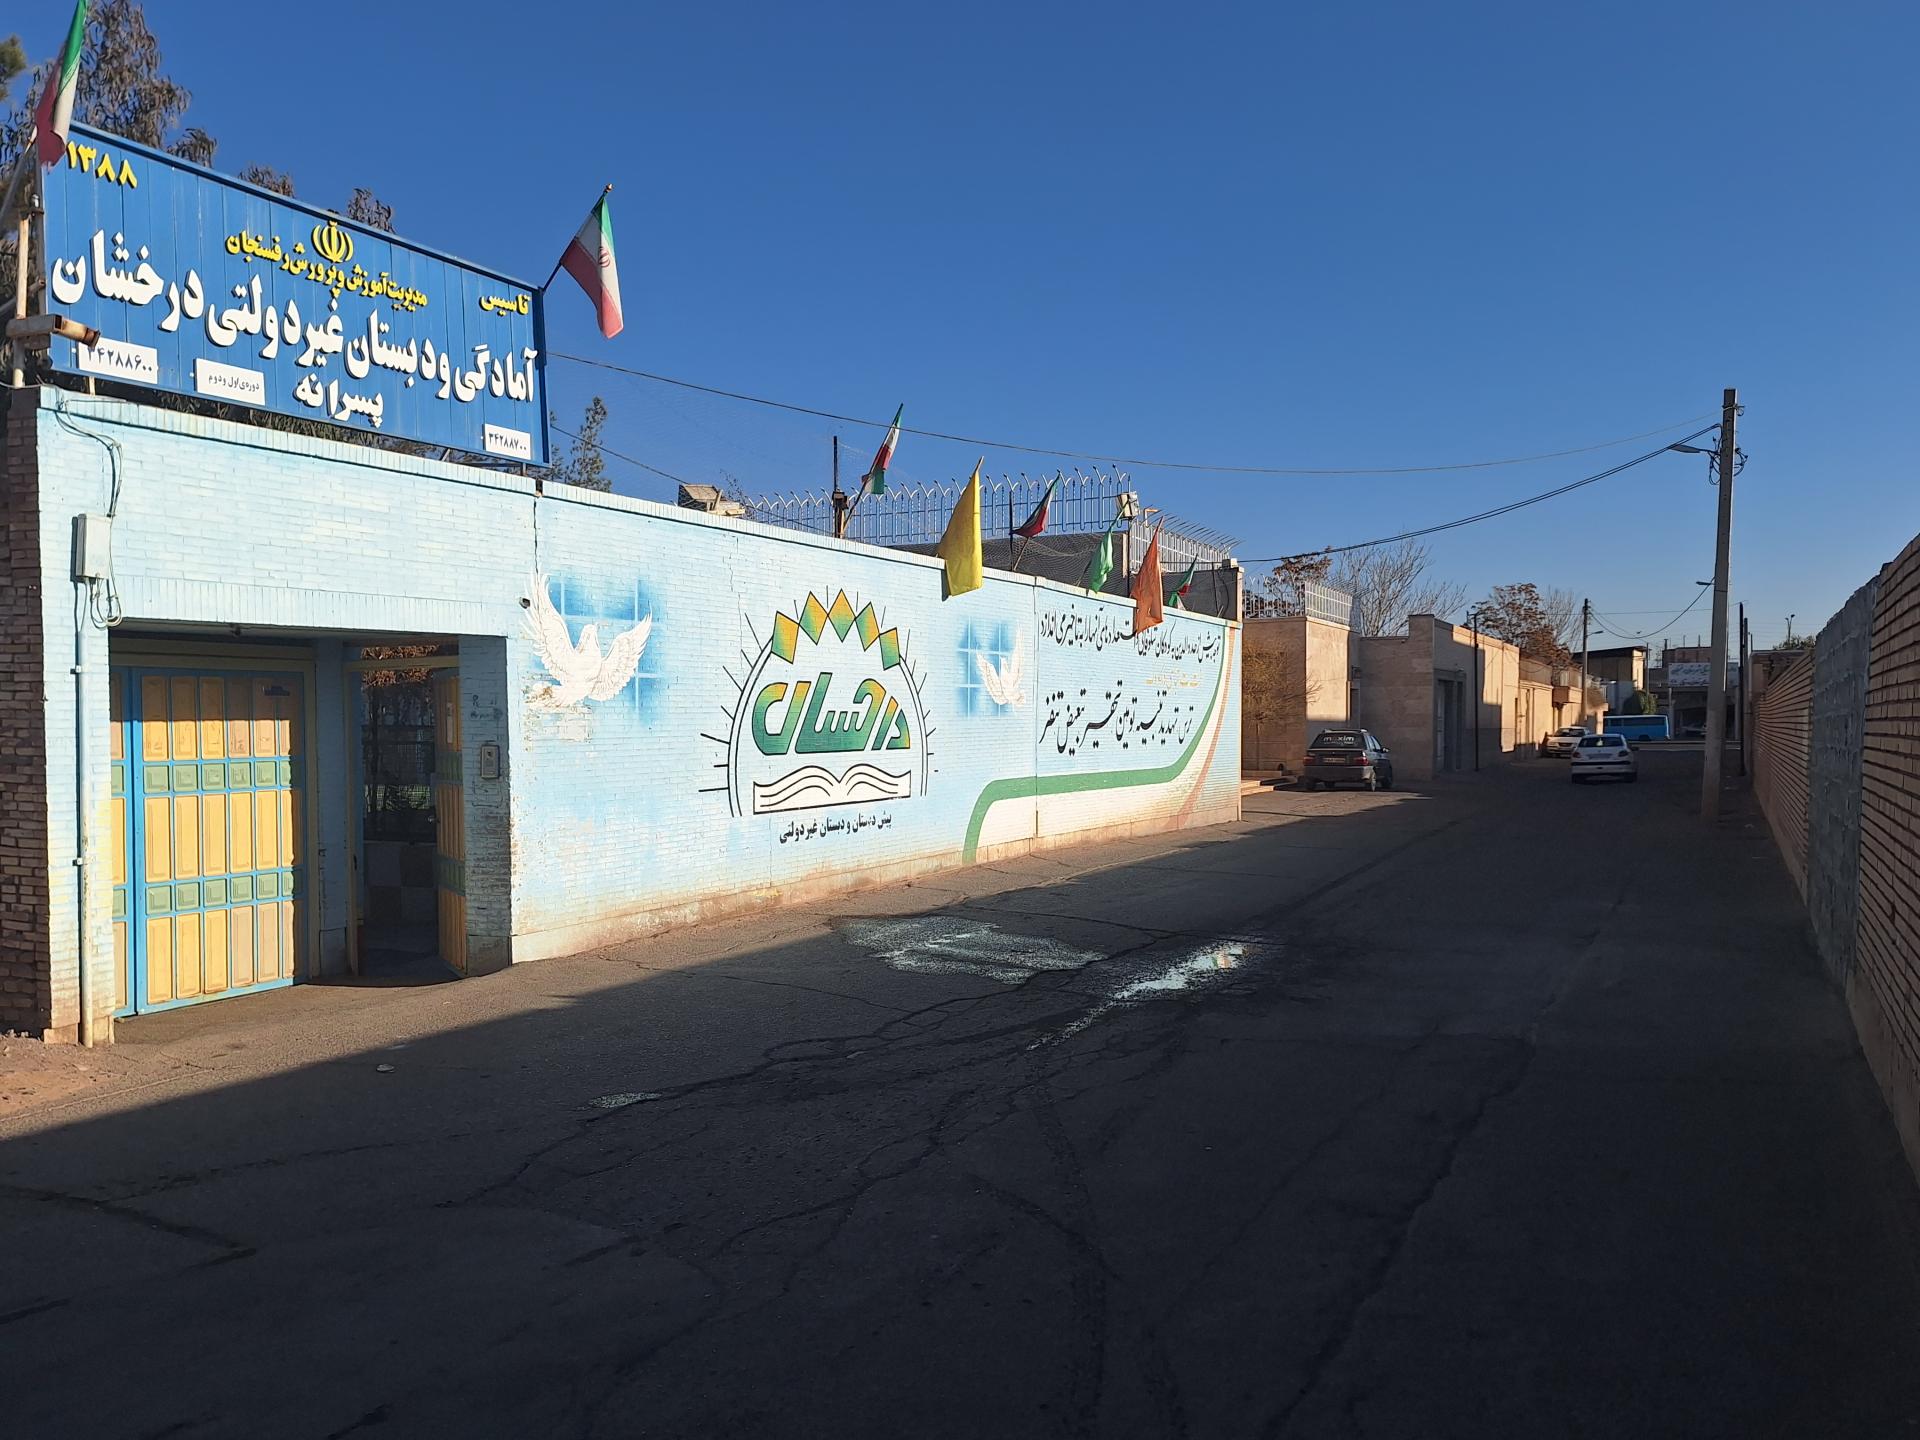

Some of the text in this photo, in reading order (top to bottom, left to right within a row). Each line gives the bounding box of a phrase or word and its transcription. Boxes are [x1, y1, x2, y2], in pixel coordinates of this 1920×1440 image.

[67, 141, 138, 188] ۱۳۸۸
[52, 229, 204, 331] درخشان
[227, 231, 428, 311] مدیریت آموزش و پرورش رفسنجان
[480, 294, 531, 314] تاسیس
[345, 309, 437, 387] دبستان
[454, 344, 538, 401] آمادگی
[295, 373, 383, 427] پسرانه
[436, 353, 450, 399] و
[489, 432, 527, 450] ۳۴۲۸۸۷۰۰
[1079, 680, 1123, 748] تحقیر
[1116, 697, 1137, 749] توهین
[1159, 707, 1179, 745] تهدید
[1179, 706, 1194, 744] ترس
[820, 816, 845, 837] دبستان
